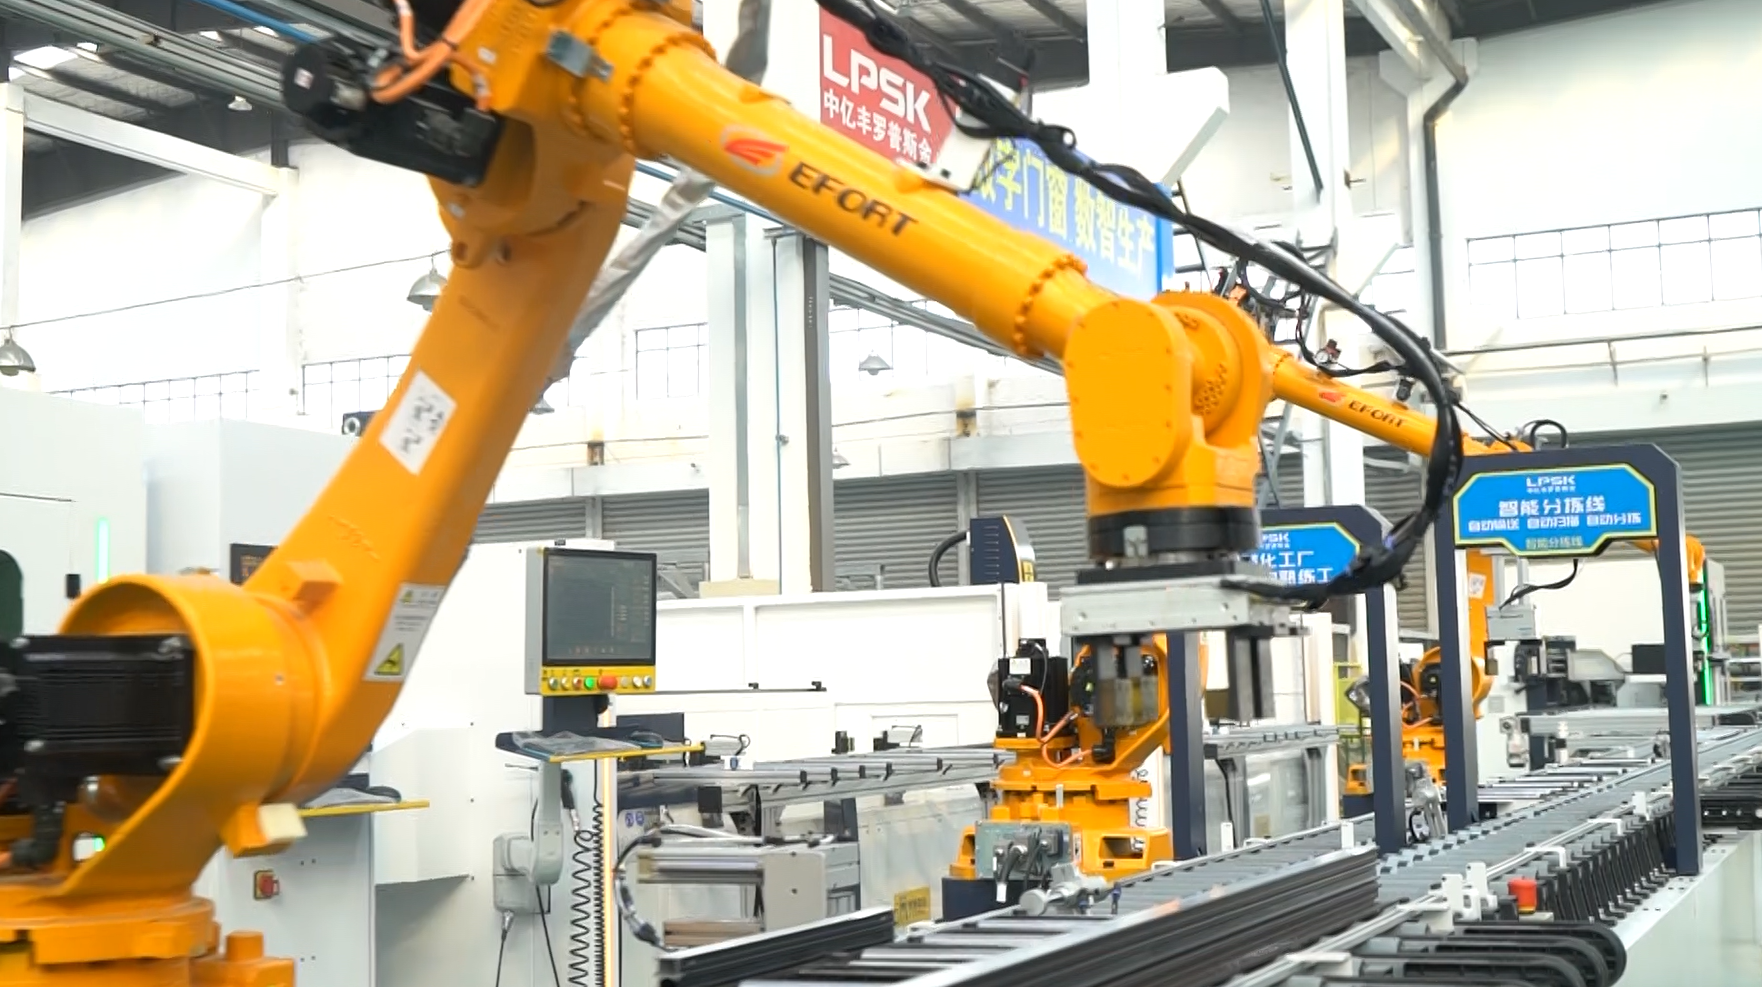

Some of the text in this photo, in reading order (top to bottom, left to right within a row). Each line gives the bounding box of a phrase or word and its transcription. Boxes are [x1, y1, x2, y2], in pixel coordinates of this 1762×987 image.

[823, 34, 931, 134] LPSK
[823, 88, 932, 165] 中亿丰罗普斯金
[788, 161, 919, 236] EFORT
[1075, 176, 1156, 280] 数智生产
[1349, 400, 1405, 428] EFORT
[1499, 495, 1606, 517] 智能分拣线
[1526, 475, 1576, 487] LPSK
[1262, 532, 1290, 542] PSK
